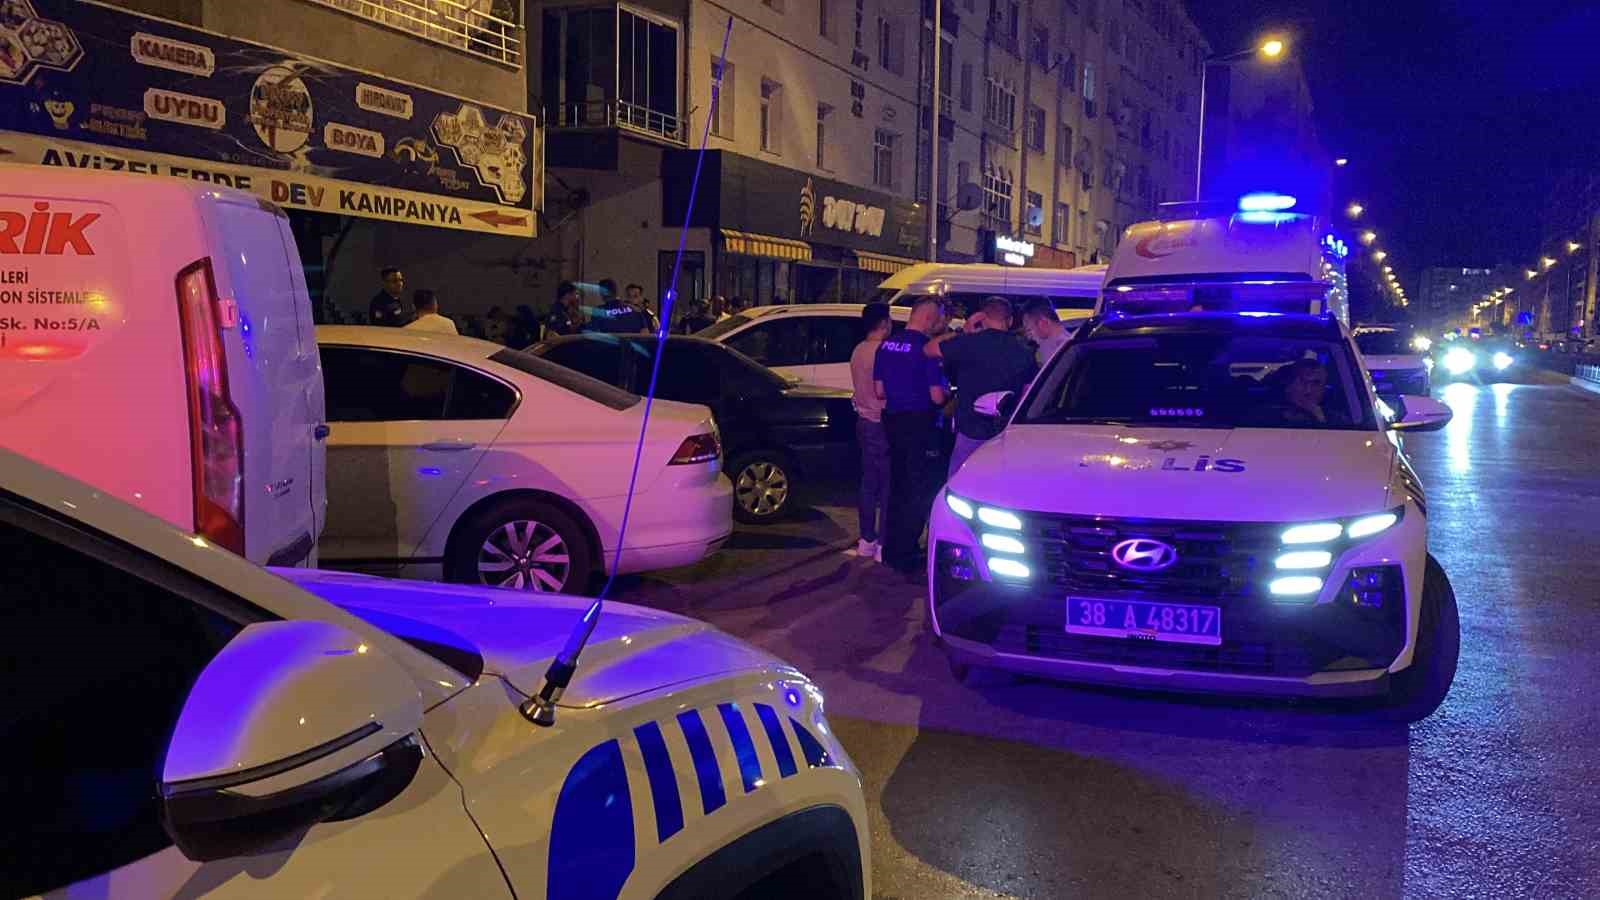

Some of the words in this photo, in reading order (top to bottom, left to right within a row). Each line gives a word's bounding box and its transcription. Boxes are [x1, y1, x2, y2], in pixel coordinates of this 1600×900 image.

[138, 38, 208, 70] KAMERA
[154, 94, 219, 122] UYDU
[331, 129, 377, 150] BOYA
[271, 180, 325, 207] DEV
[339, 190, 462, 224] KAMPANYA
[0, 267, 28, 284] LERİ
[0, 290, 22, 304] ON
[27, 288, 104, 304] SİSTEMLE
[34, 317, 101, 332] No:5/A
[1079, 602, 1106, 625] 38
[1123, 604, 1137, 629] A
[1146, 606, 1215, 633] 48317
